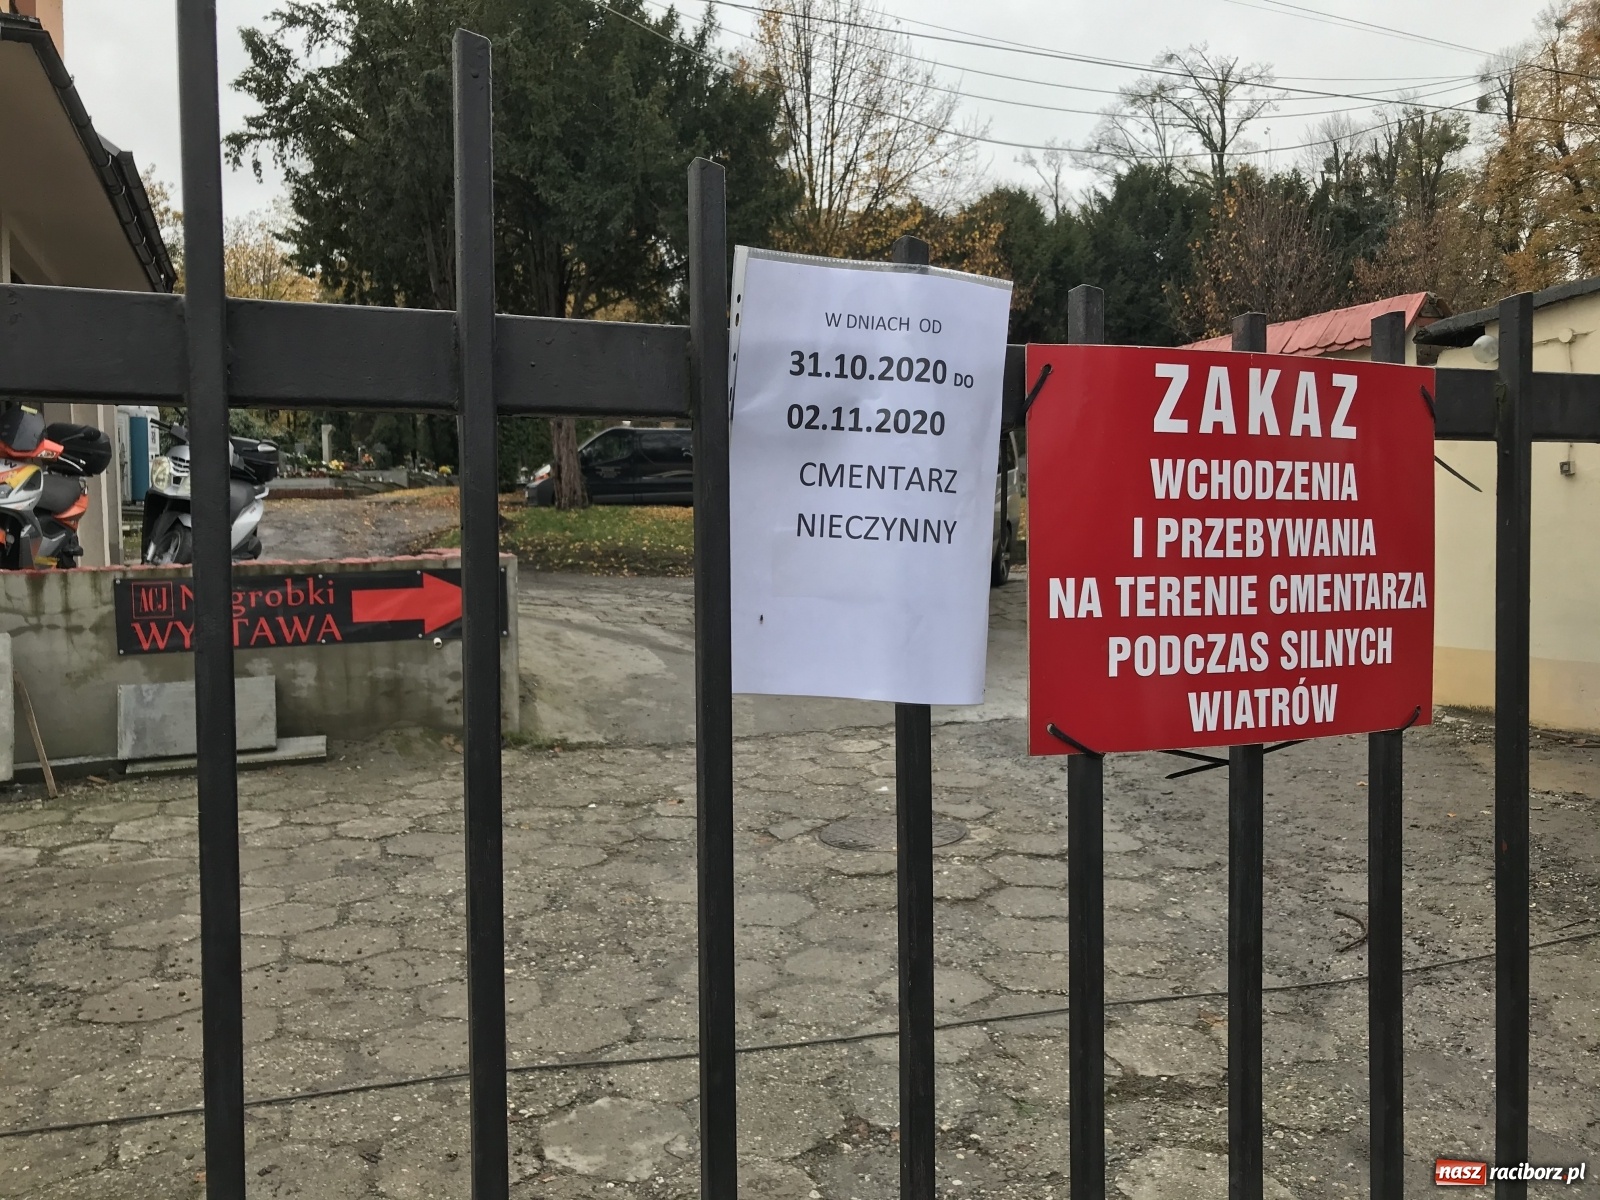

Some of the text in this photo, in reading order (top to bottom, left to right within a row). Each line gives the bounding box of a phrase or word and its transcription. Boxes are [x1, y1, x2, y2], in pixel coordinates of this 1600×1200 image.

[825, 312, 942, 334] W DNIACH OD
[789, 350, 974, 389] 31.10.2020 DO
[787, 403, 946, 436] 02.11.2020
[1153, 363, 1358, 439] ZAKAZ
[799, 461, 958, 494] CMENTARZ
[1150, 458, 1358, 501] WCHODZENIA
[796, 512, 958, 545] NIECZYNNY
[1133, 517, 1377, 558] I PRZEBYWANIA
[180, 577, 335, 617] Ngrobki
[1049, 572, 1427, 619] NA TERENIE CMENTARZA
[131, 613, 342, 651] WYTAWA
[1108, 627, 1393, 677] PODCZAS SILNYCH
[1187, 677, 1339, 732] WIATRÓW
